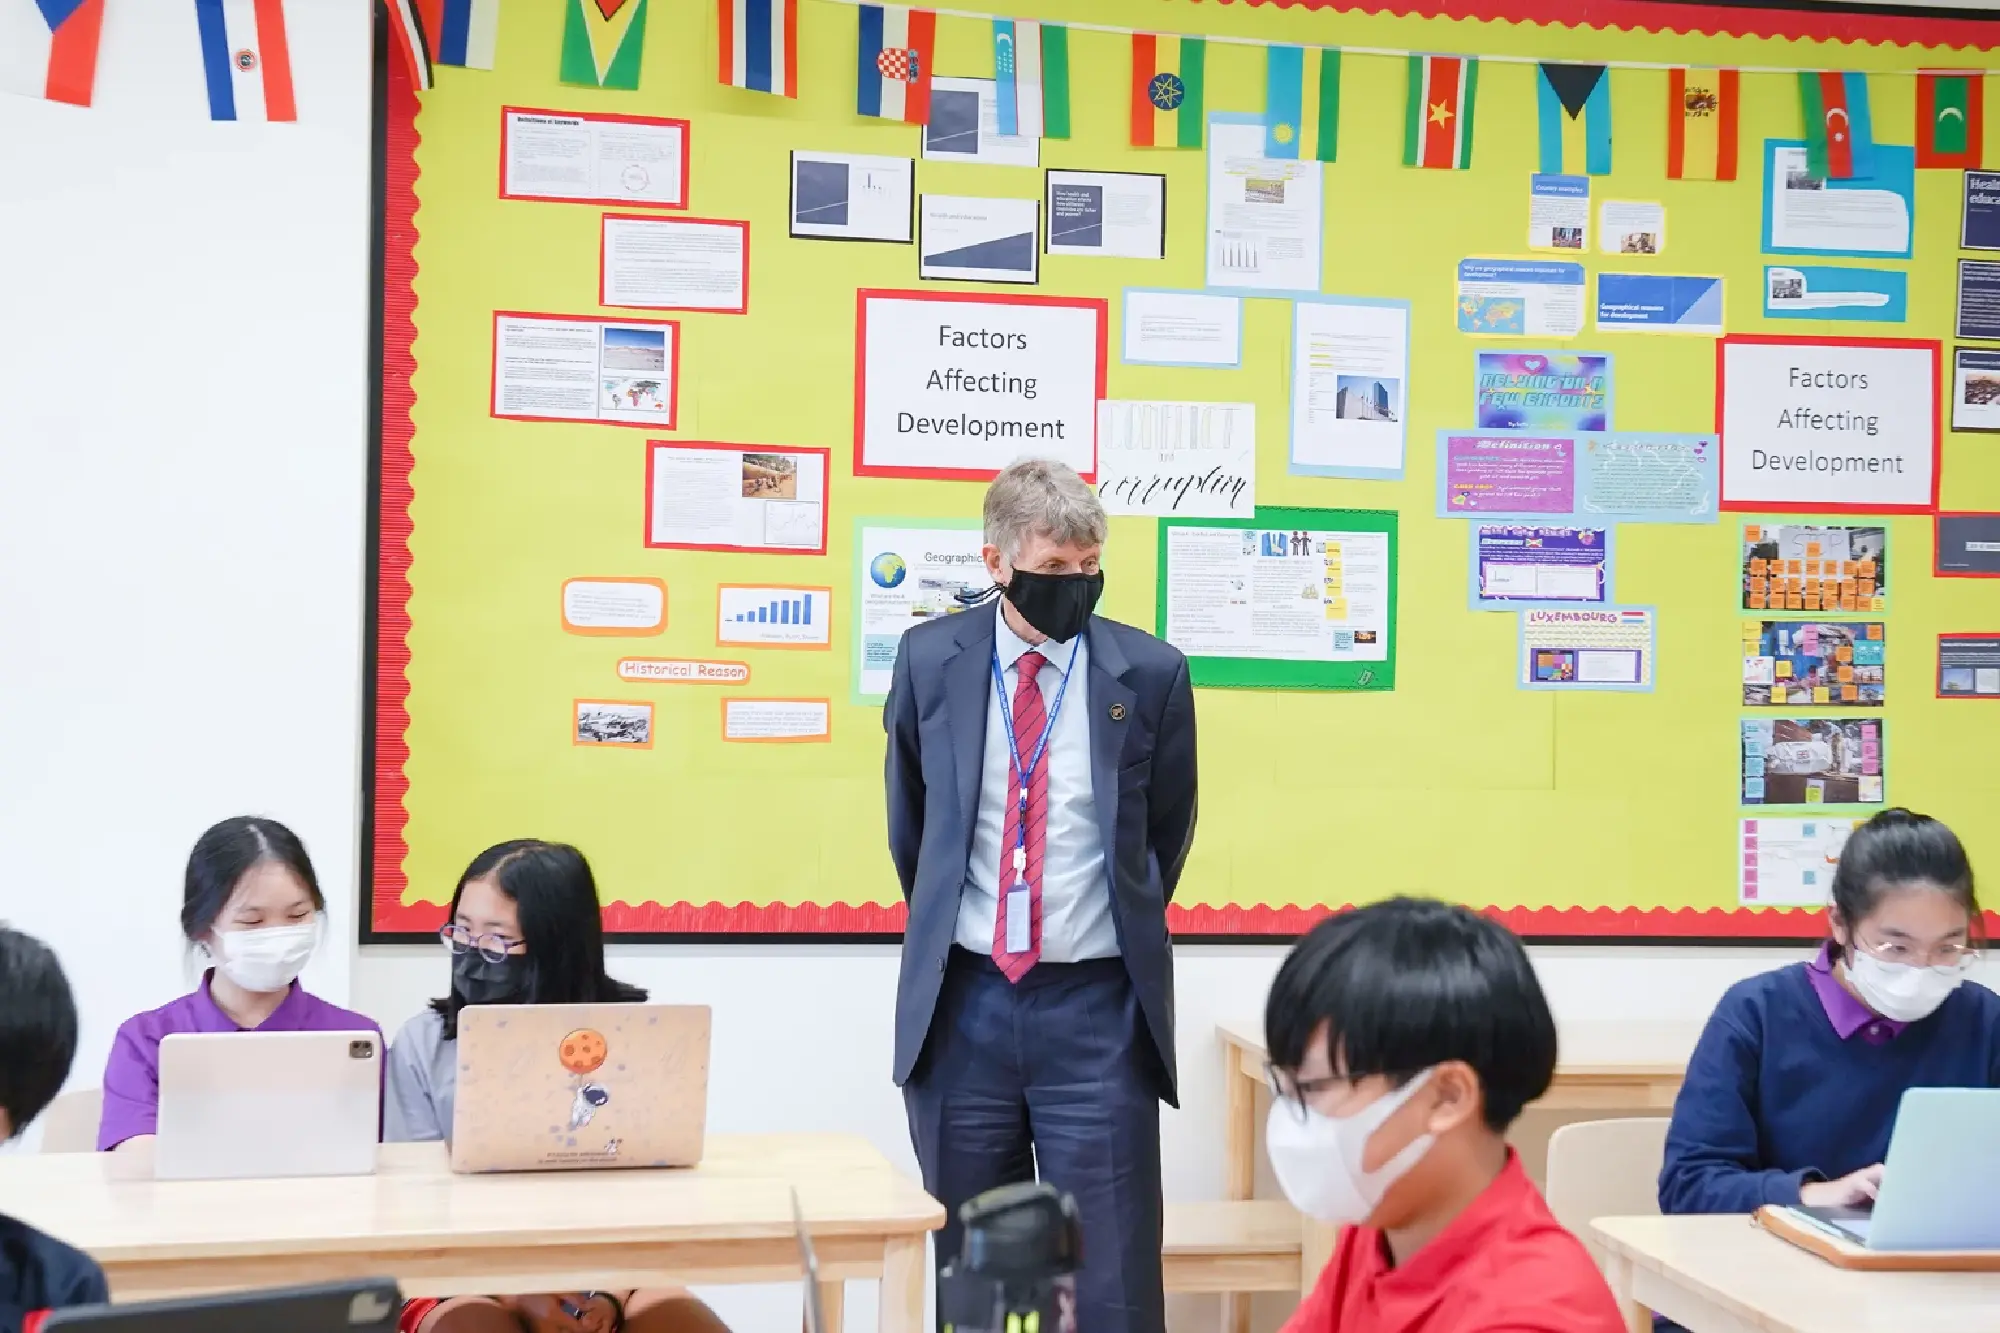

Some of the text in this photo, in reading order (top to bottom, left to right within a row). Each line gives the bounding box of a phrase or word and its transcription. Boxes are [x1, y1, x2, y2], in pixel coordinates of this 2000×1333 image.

[939, 325, 1028, 350] Factors
[926, 369, 1038, 399] Affecting
[1789, 367, 1869, 389] Factors
[1479, 391, 1521, 406] FEW
[897, 412, 1065, 441] Development
[1777, 408, 1880, 436] Affecting
[1751, 449, 1905, 476] Development
[924, 551, 985, 564] Geographic
[1530, 611, 1618, 623] LUXEMBOURG
[624, 662, 746, 678] Historical Reason
